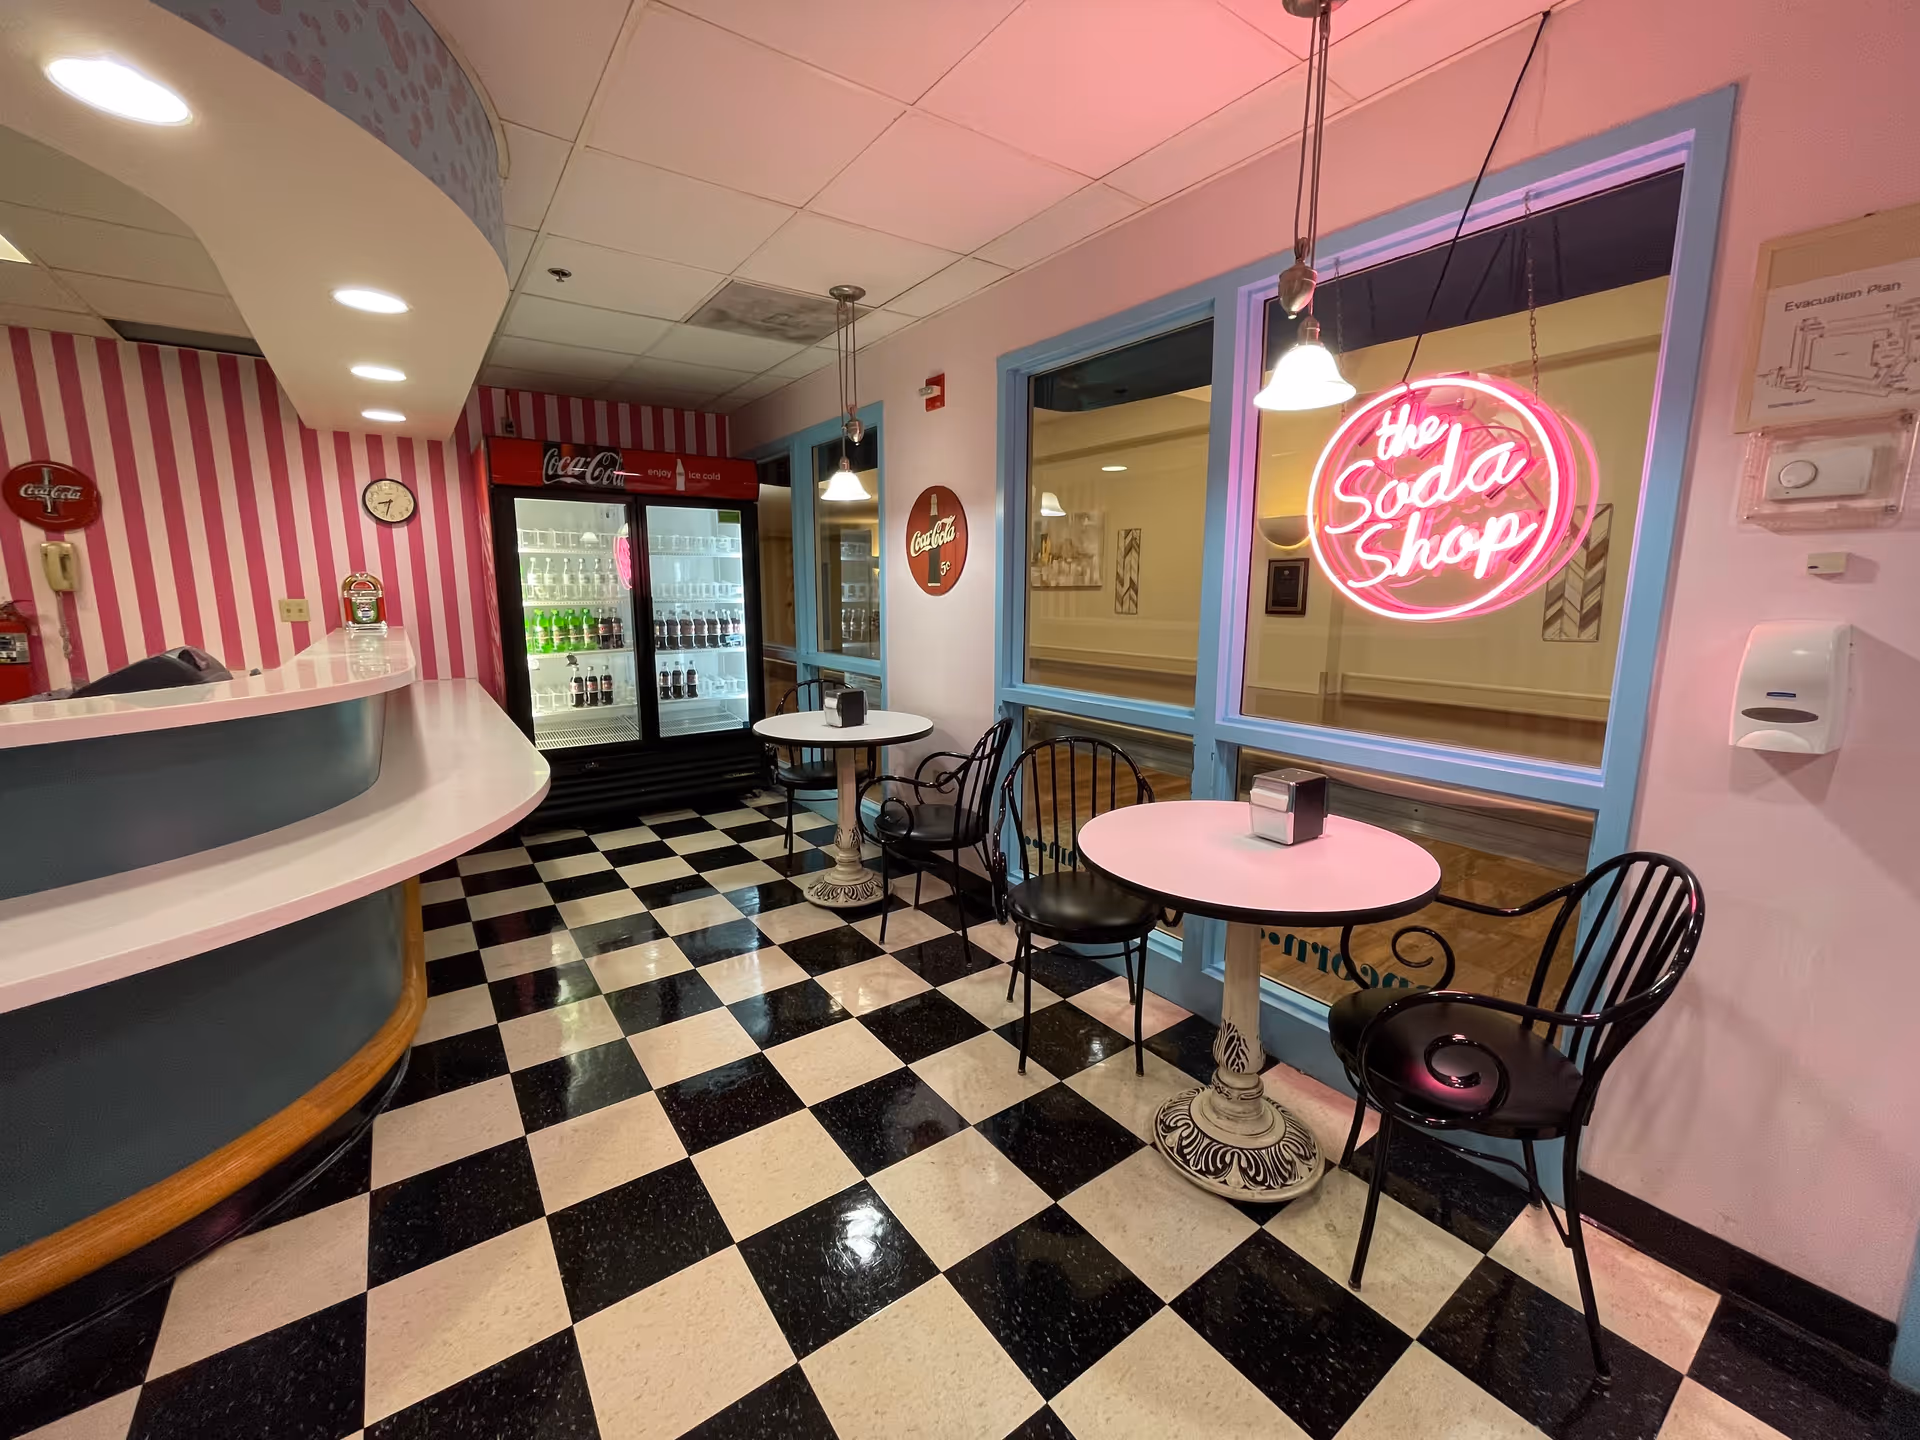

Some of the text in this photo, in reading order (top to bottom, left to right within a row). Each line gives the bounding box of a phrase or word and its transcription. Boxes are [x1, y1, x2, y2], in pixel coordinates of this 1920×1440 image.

[1783, 289, 1863, 313] Evacuation
[1375, 404, 1451, 461] the
[647, 468, 721, 481] enjoy ice cold
[1324, 423, 1527, 535] Soda
[910, 515, 956, 557] Coca-Cola
[1346, 511, 1539, 588] Shop
